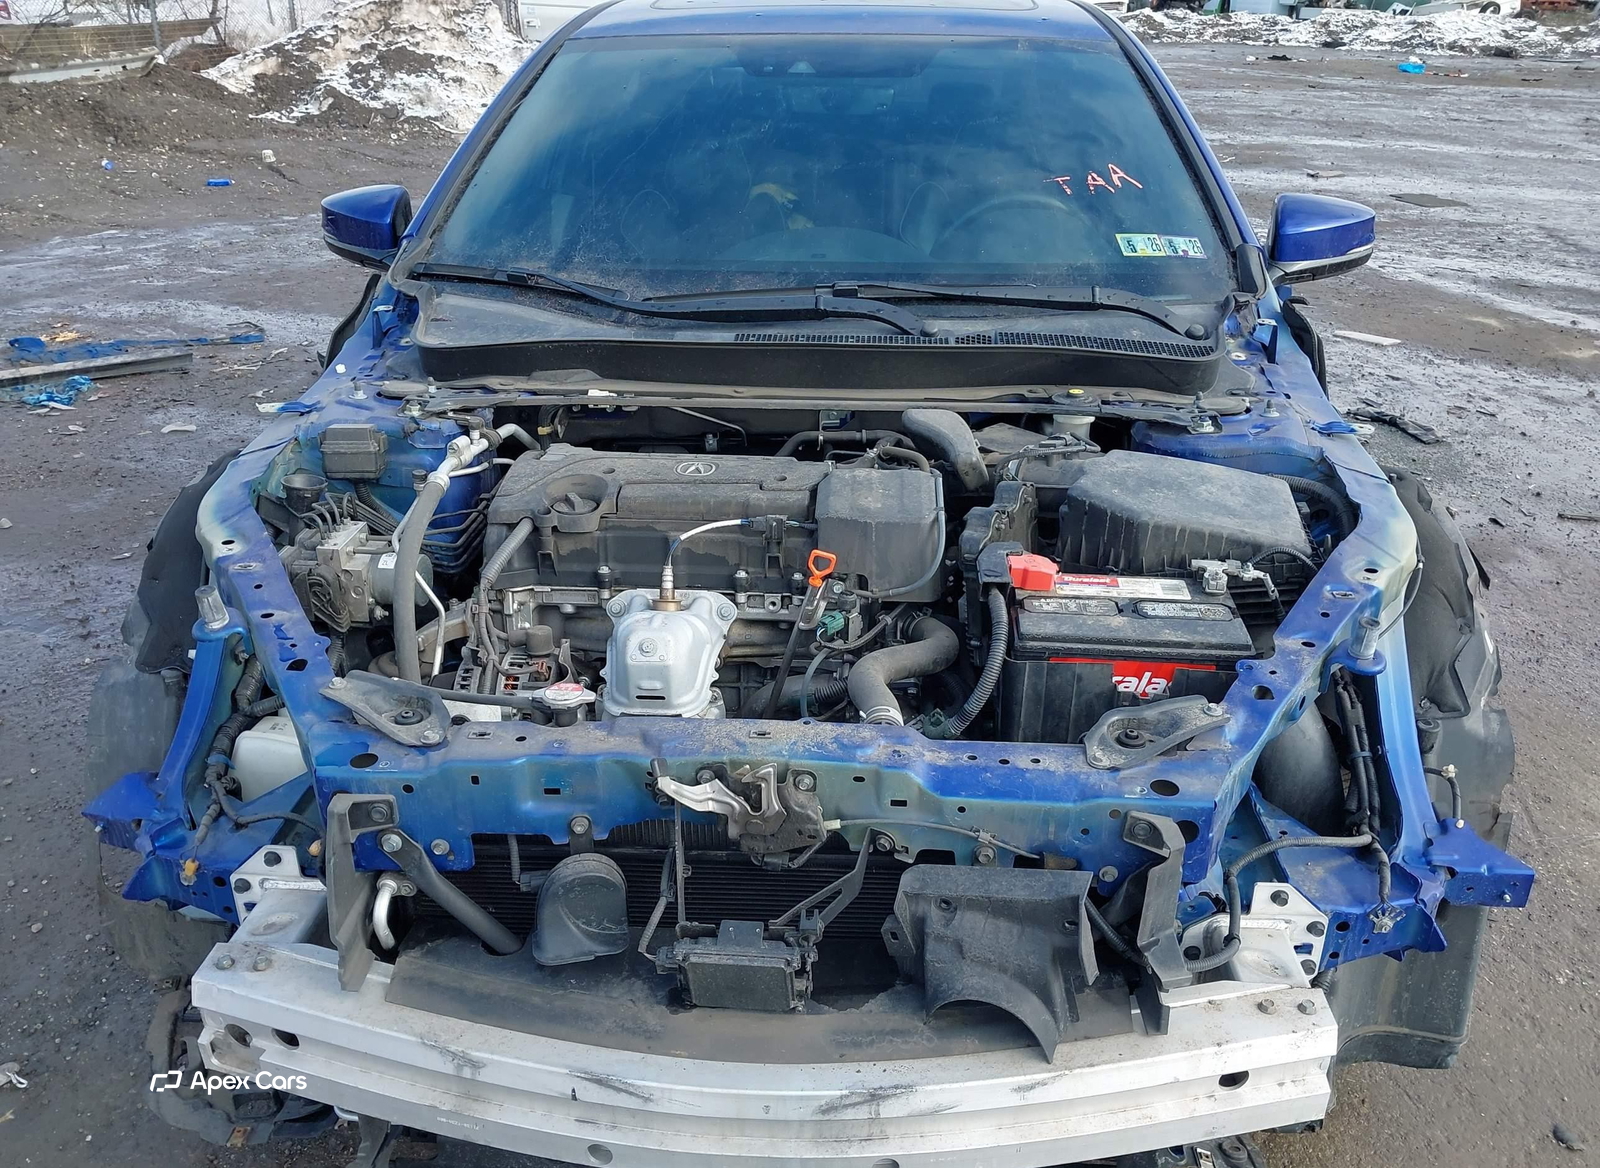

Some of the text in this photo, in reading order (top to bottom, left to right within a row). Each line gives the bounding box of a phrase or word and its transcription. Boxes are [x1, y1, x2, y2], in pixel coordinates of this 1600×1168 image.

[1127, 237, 1162, 253] 5 26
[1169, 239, 1203, 254] 5 26
[1112, 671, 1172, 695] rala
